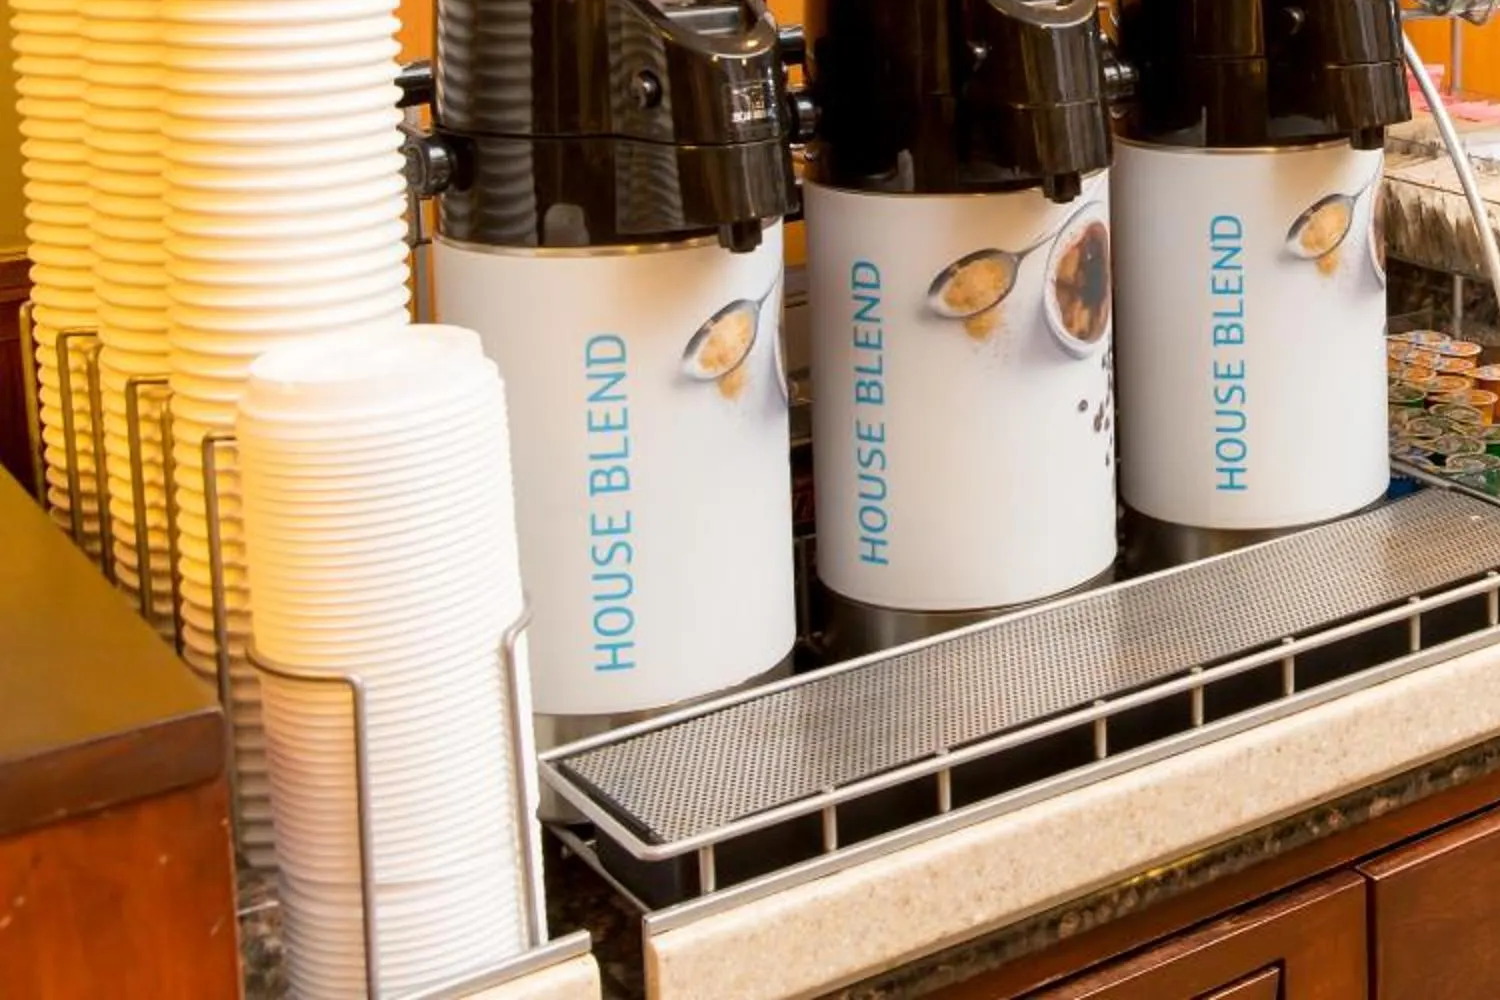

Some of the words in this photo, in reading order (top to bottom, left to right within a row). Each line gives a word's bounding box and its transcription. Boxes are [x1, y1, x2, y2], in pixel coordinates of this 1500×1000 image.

[851, 260, 885, 405] BLEND
[1210, 214, 1244, 346] BLEND
[585, 334, 631, 496] BLEND
[1213, 360, 1249, 491] HOUSE
[855, 420, 890, 566] HOUSE
[590, 510, 636, 672] HOUSE
